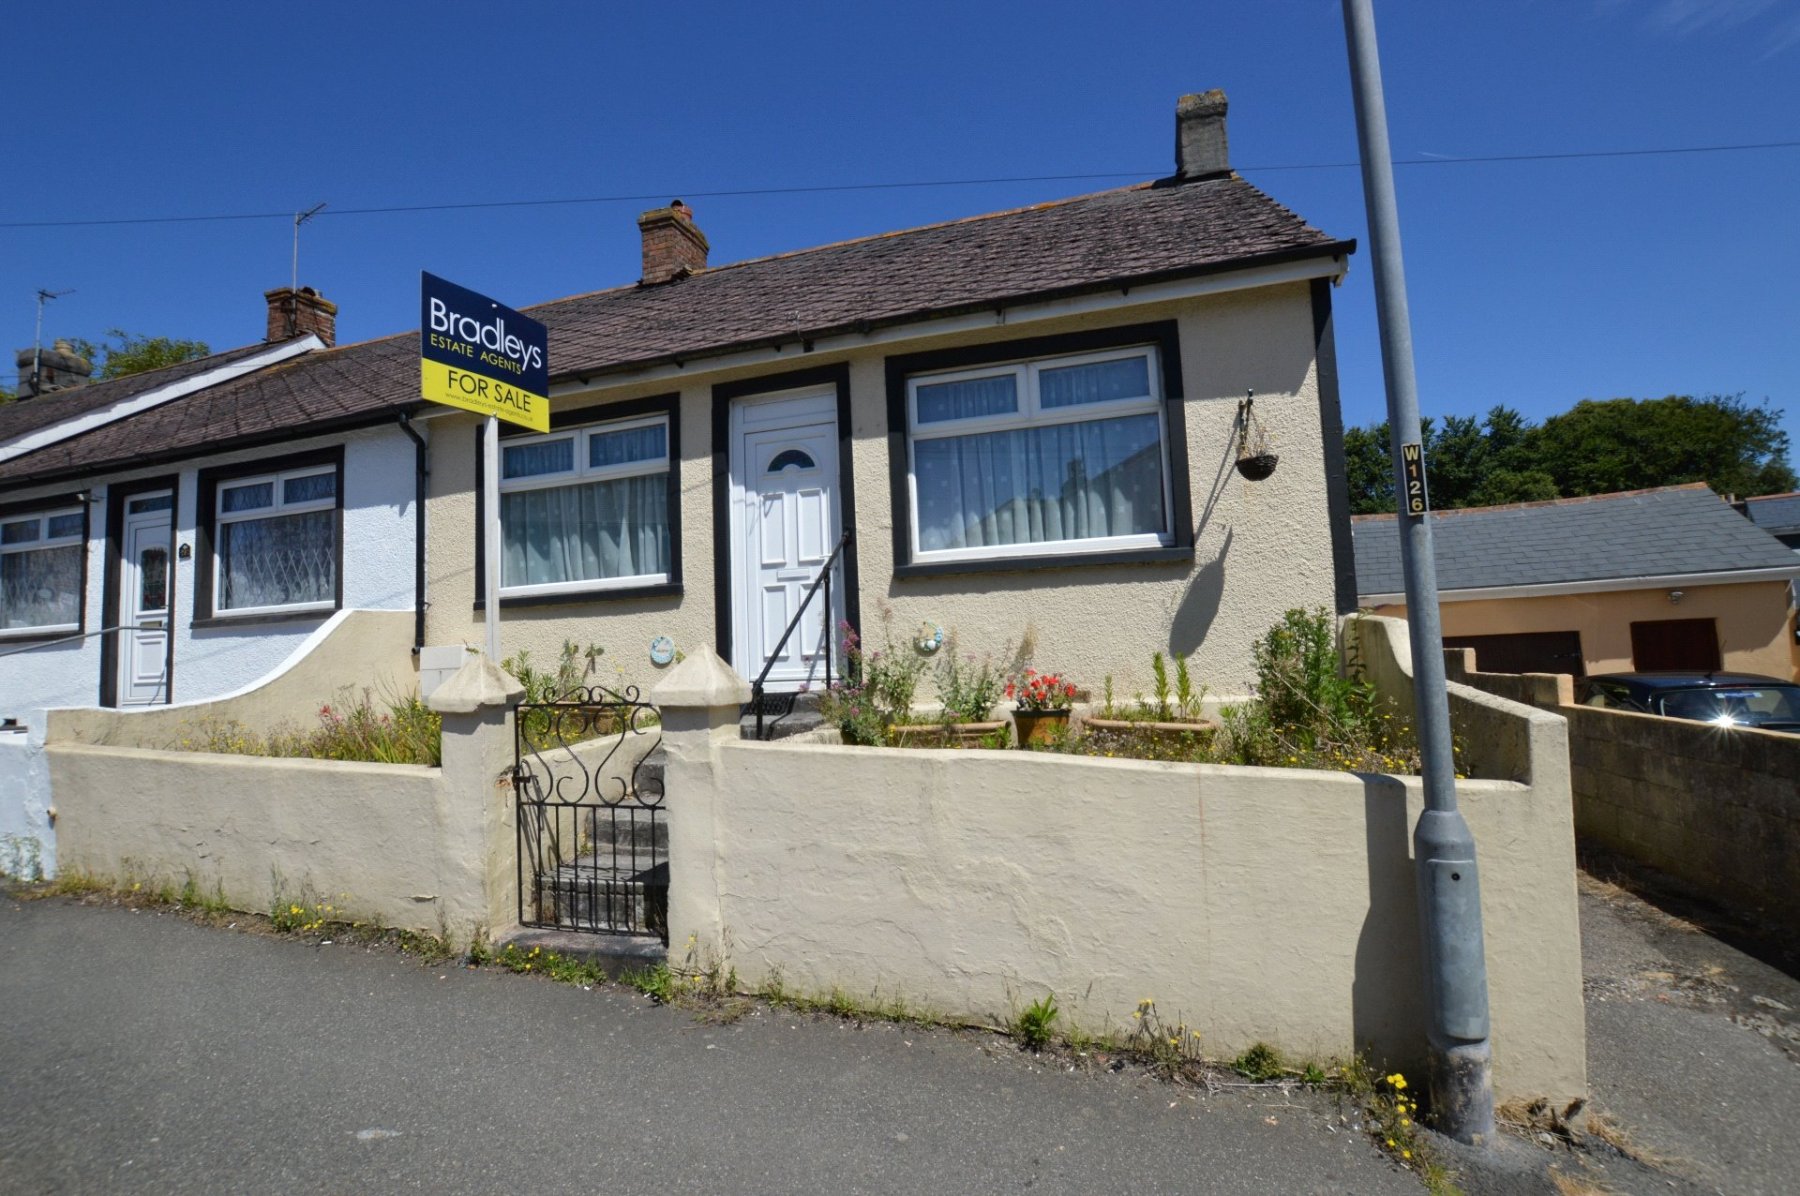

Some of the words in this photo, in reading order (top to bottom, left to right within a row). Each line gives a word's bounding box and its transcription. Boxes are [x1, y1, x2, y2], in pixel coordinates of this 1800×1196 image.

[430, 296, 542, 371] Bradleys
[430, 333, 474, 358] ESTATE
[480, 351, 522, 375] AGENTS
[448, 369, 488, 399] FOR
[494, 383, 531, 413] SALE
[1404, 446, 1423, 512] W126
